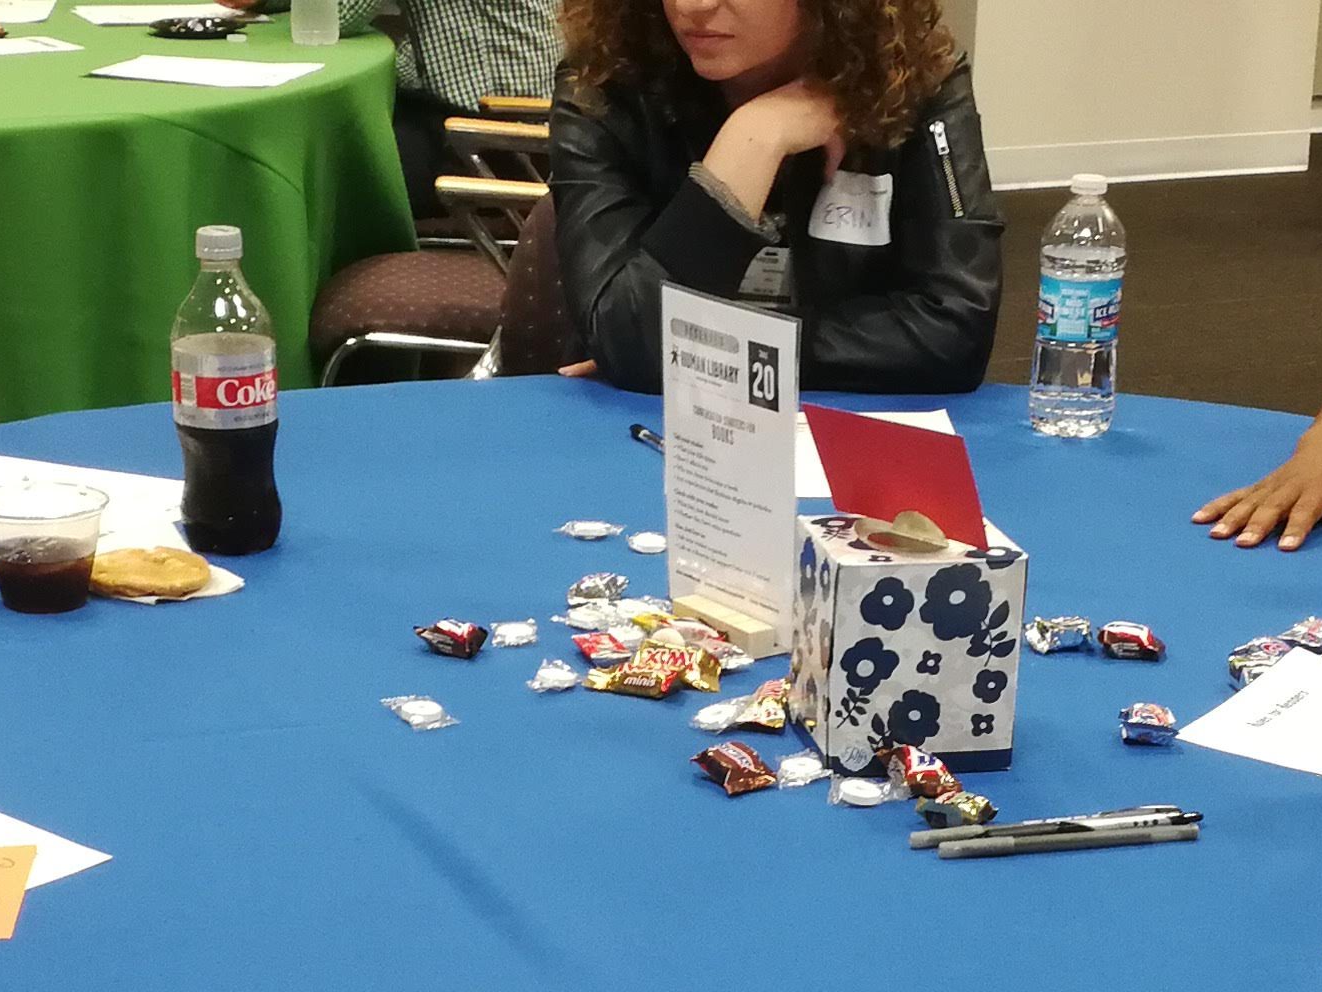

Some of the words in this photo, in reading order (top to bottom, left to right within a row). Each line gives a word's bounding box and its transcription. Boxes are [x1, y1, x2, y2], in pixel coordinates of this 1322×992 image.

[707, 358, 739, 384] LIBRARY
[752, 361, 775, 401] 20
[217, 376, 275, 407] Coke
[623, 677, 656, 688] minis
